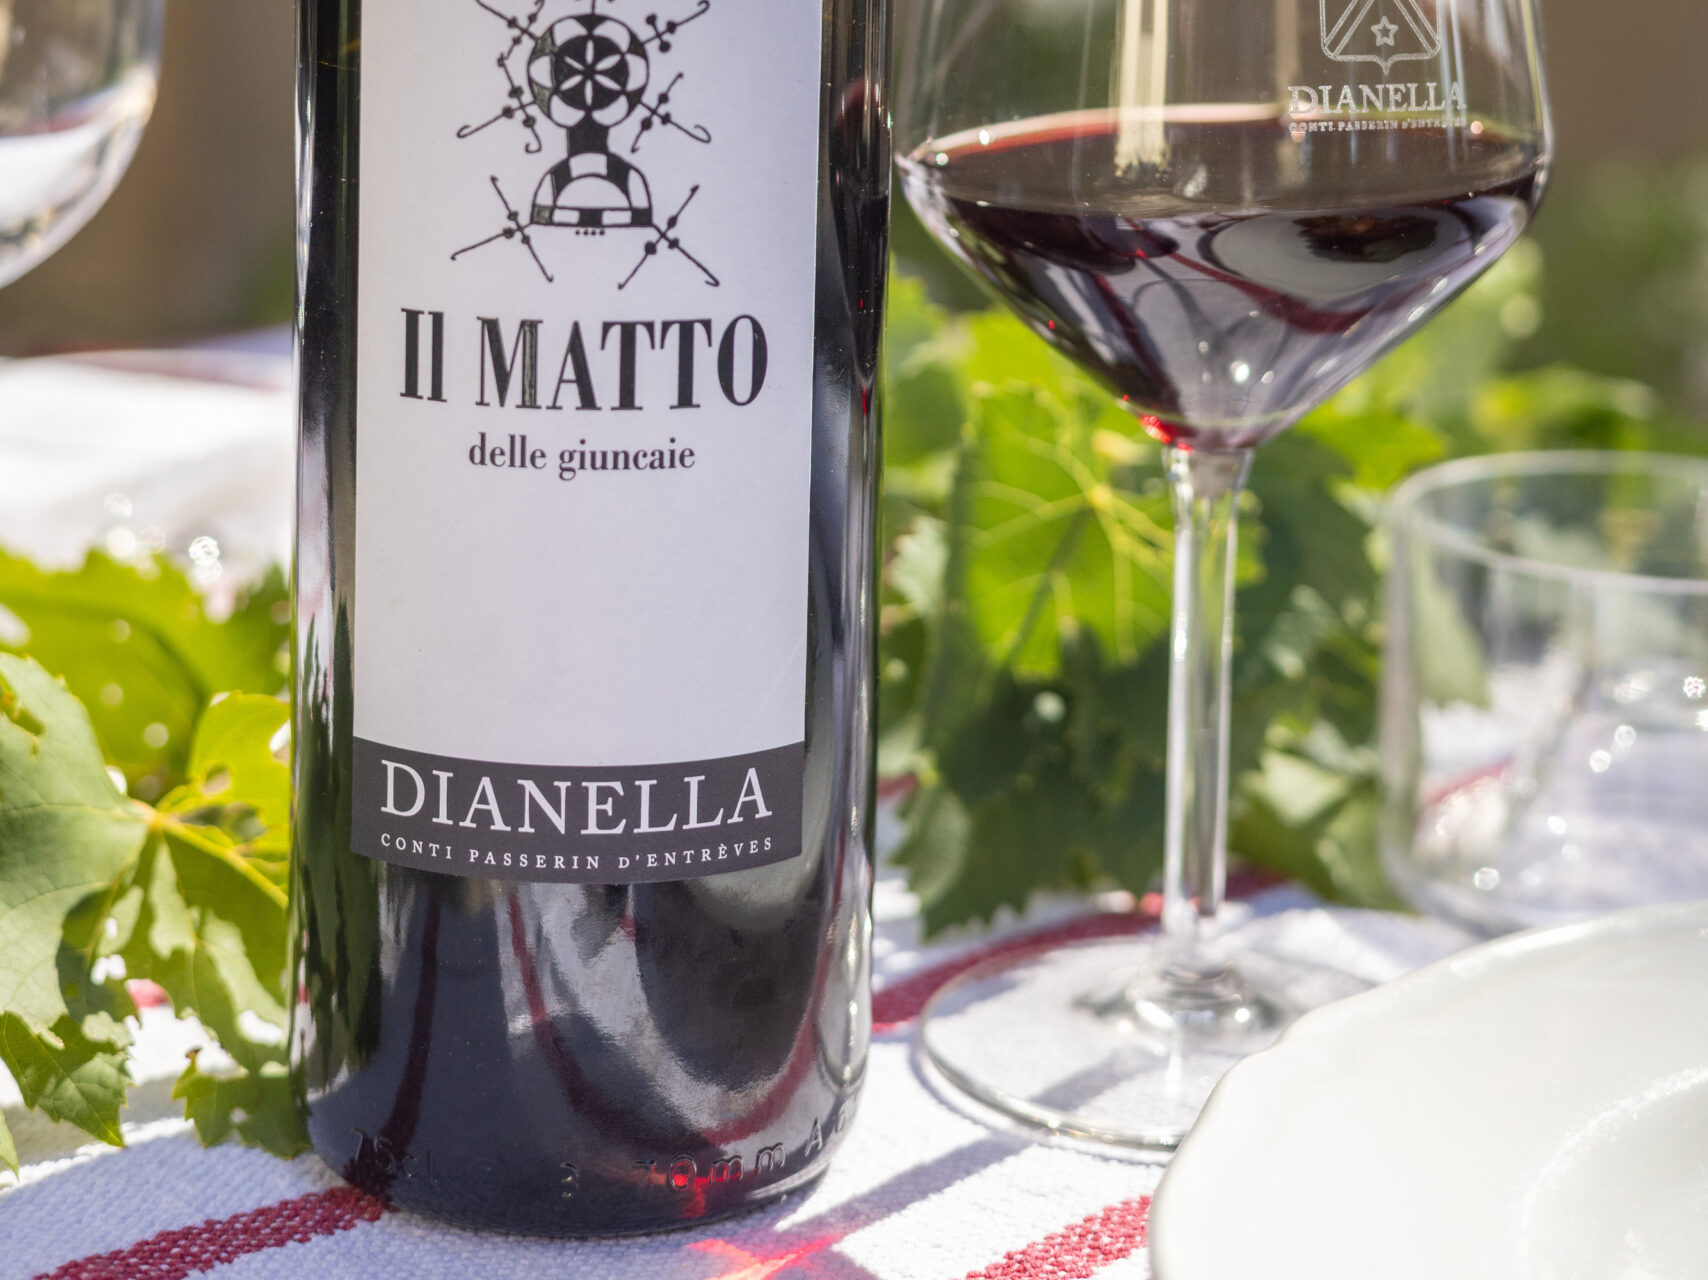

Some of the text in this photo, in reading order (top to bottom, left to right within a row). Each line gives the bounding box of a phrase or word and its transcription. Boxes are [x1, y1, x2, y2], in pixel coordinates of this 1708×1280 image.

[1288, 81, 1467, 114] DIANELLA
[1288, 121, 1335, 133] CONTI
[1338, 119, 1398, 132] PASSERIN
[475, 314, 768, 411] MATTO
[468, 432, 696, 481] delle giuncaie
[381, 759, 773, 835] DIANELLA
[381, 833, 772, 869] CONTI PASSERIN D'ENTRÈVES
